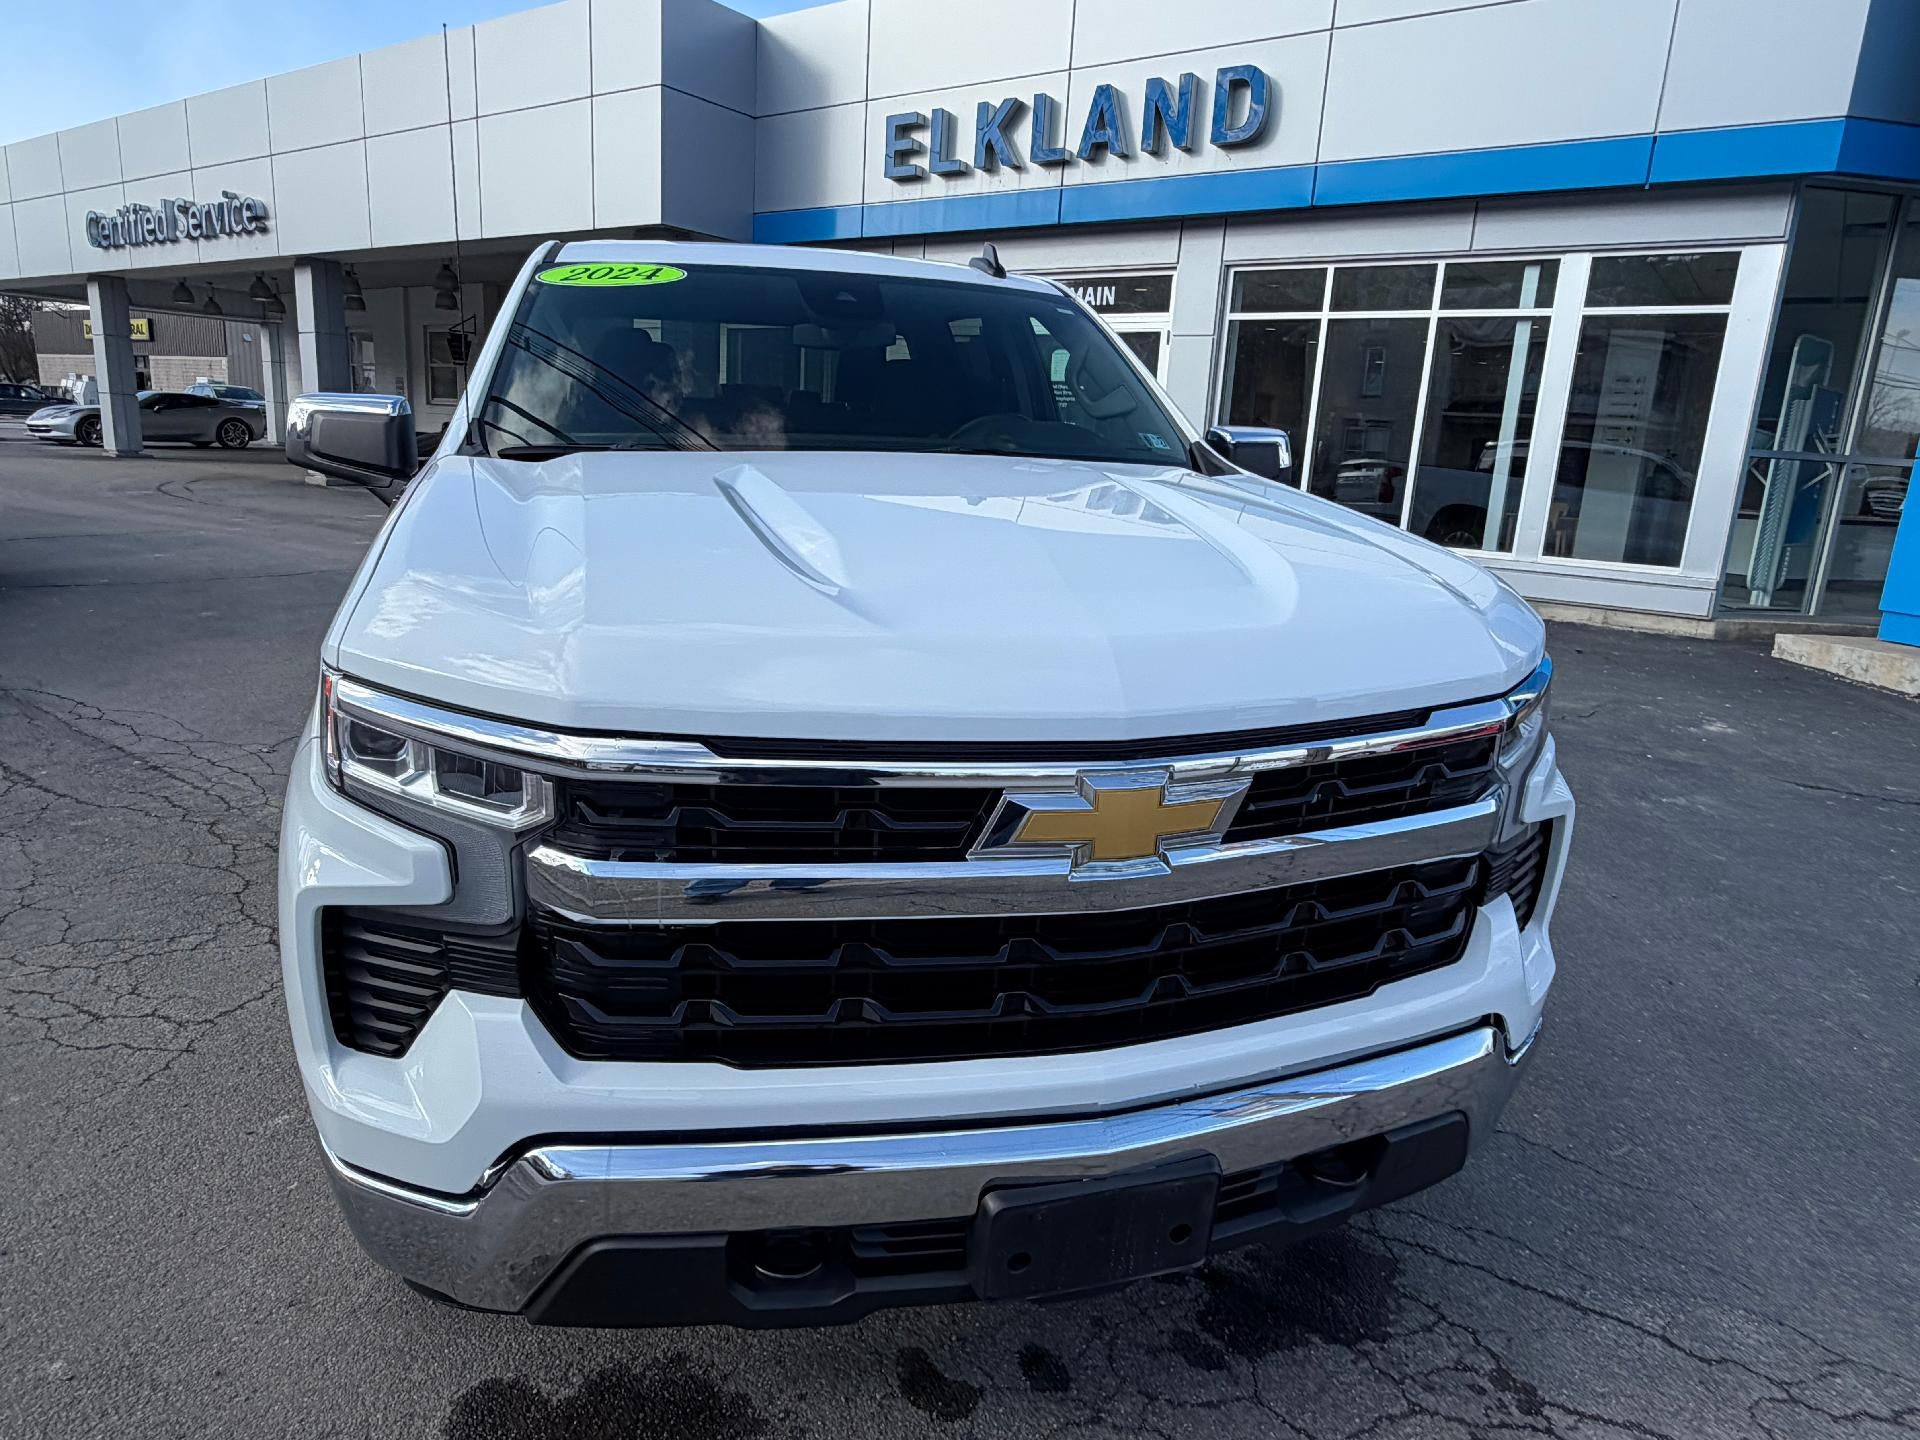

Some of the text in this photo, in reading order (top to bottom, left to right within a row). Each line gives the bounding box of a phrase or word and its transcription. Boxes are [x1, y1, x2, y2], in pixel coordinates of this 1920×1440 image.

[883, 64, 1274, 182] ELKLAND
[86, 190, 270, 249] Certified Service
[559, 265, 664, 282] 2024
[1070, 286, 1116, 306] MAIN
